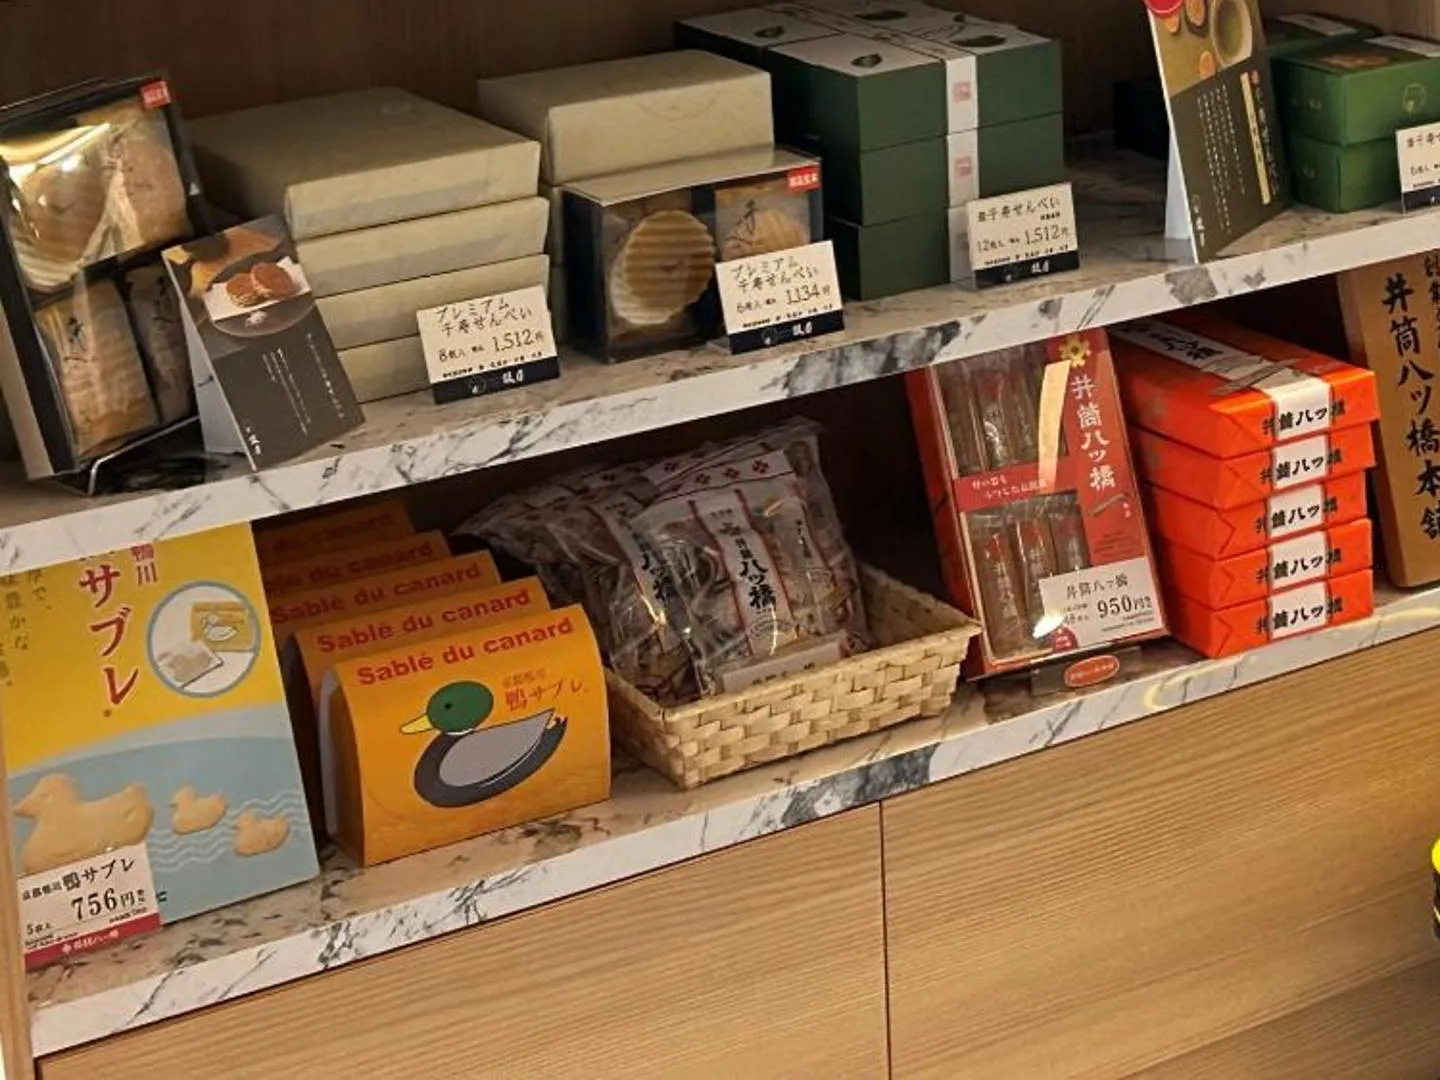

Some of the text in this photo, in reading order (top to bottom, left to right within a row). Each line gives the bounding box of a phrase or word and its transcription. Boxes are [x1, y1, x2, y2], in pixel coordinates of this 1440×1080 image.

[436, 297, 509, 323] プレミアム
[393, 563, 481, 596] canard
[401, 613, 434, 634] du
[441, 588, 532, 624] canard
[356, 617, 575, 687] Sablé du canard
[71, 887, 135, 921] 756円
